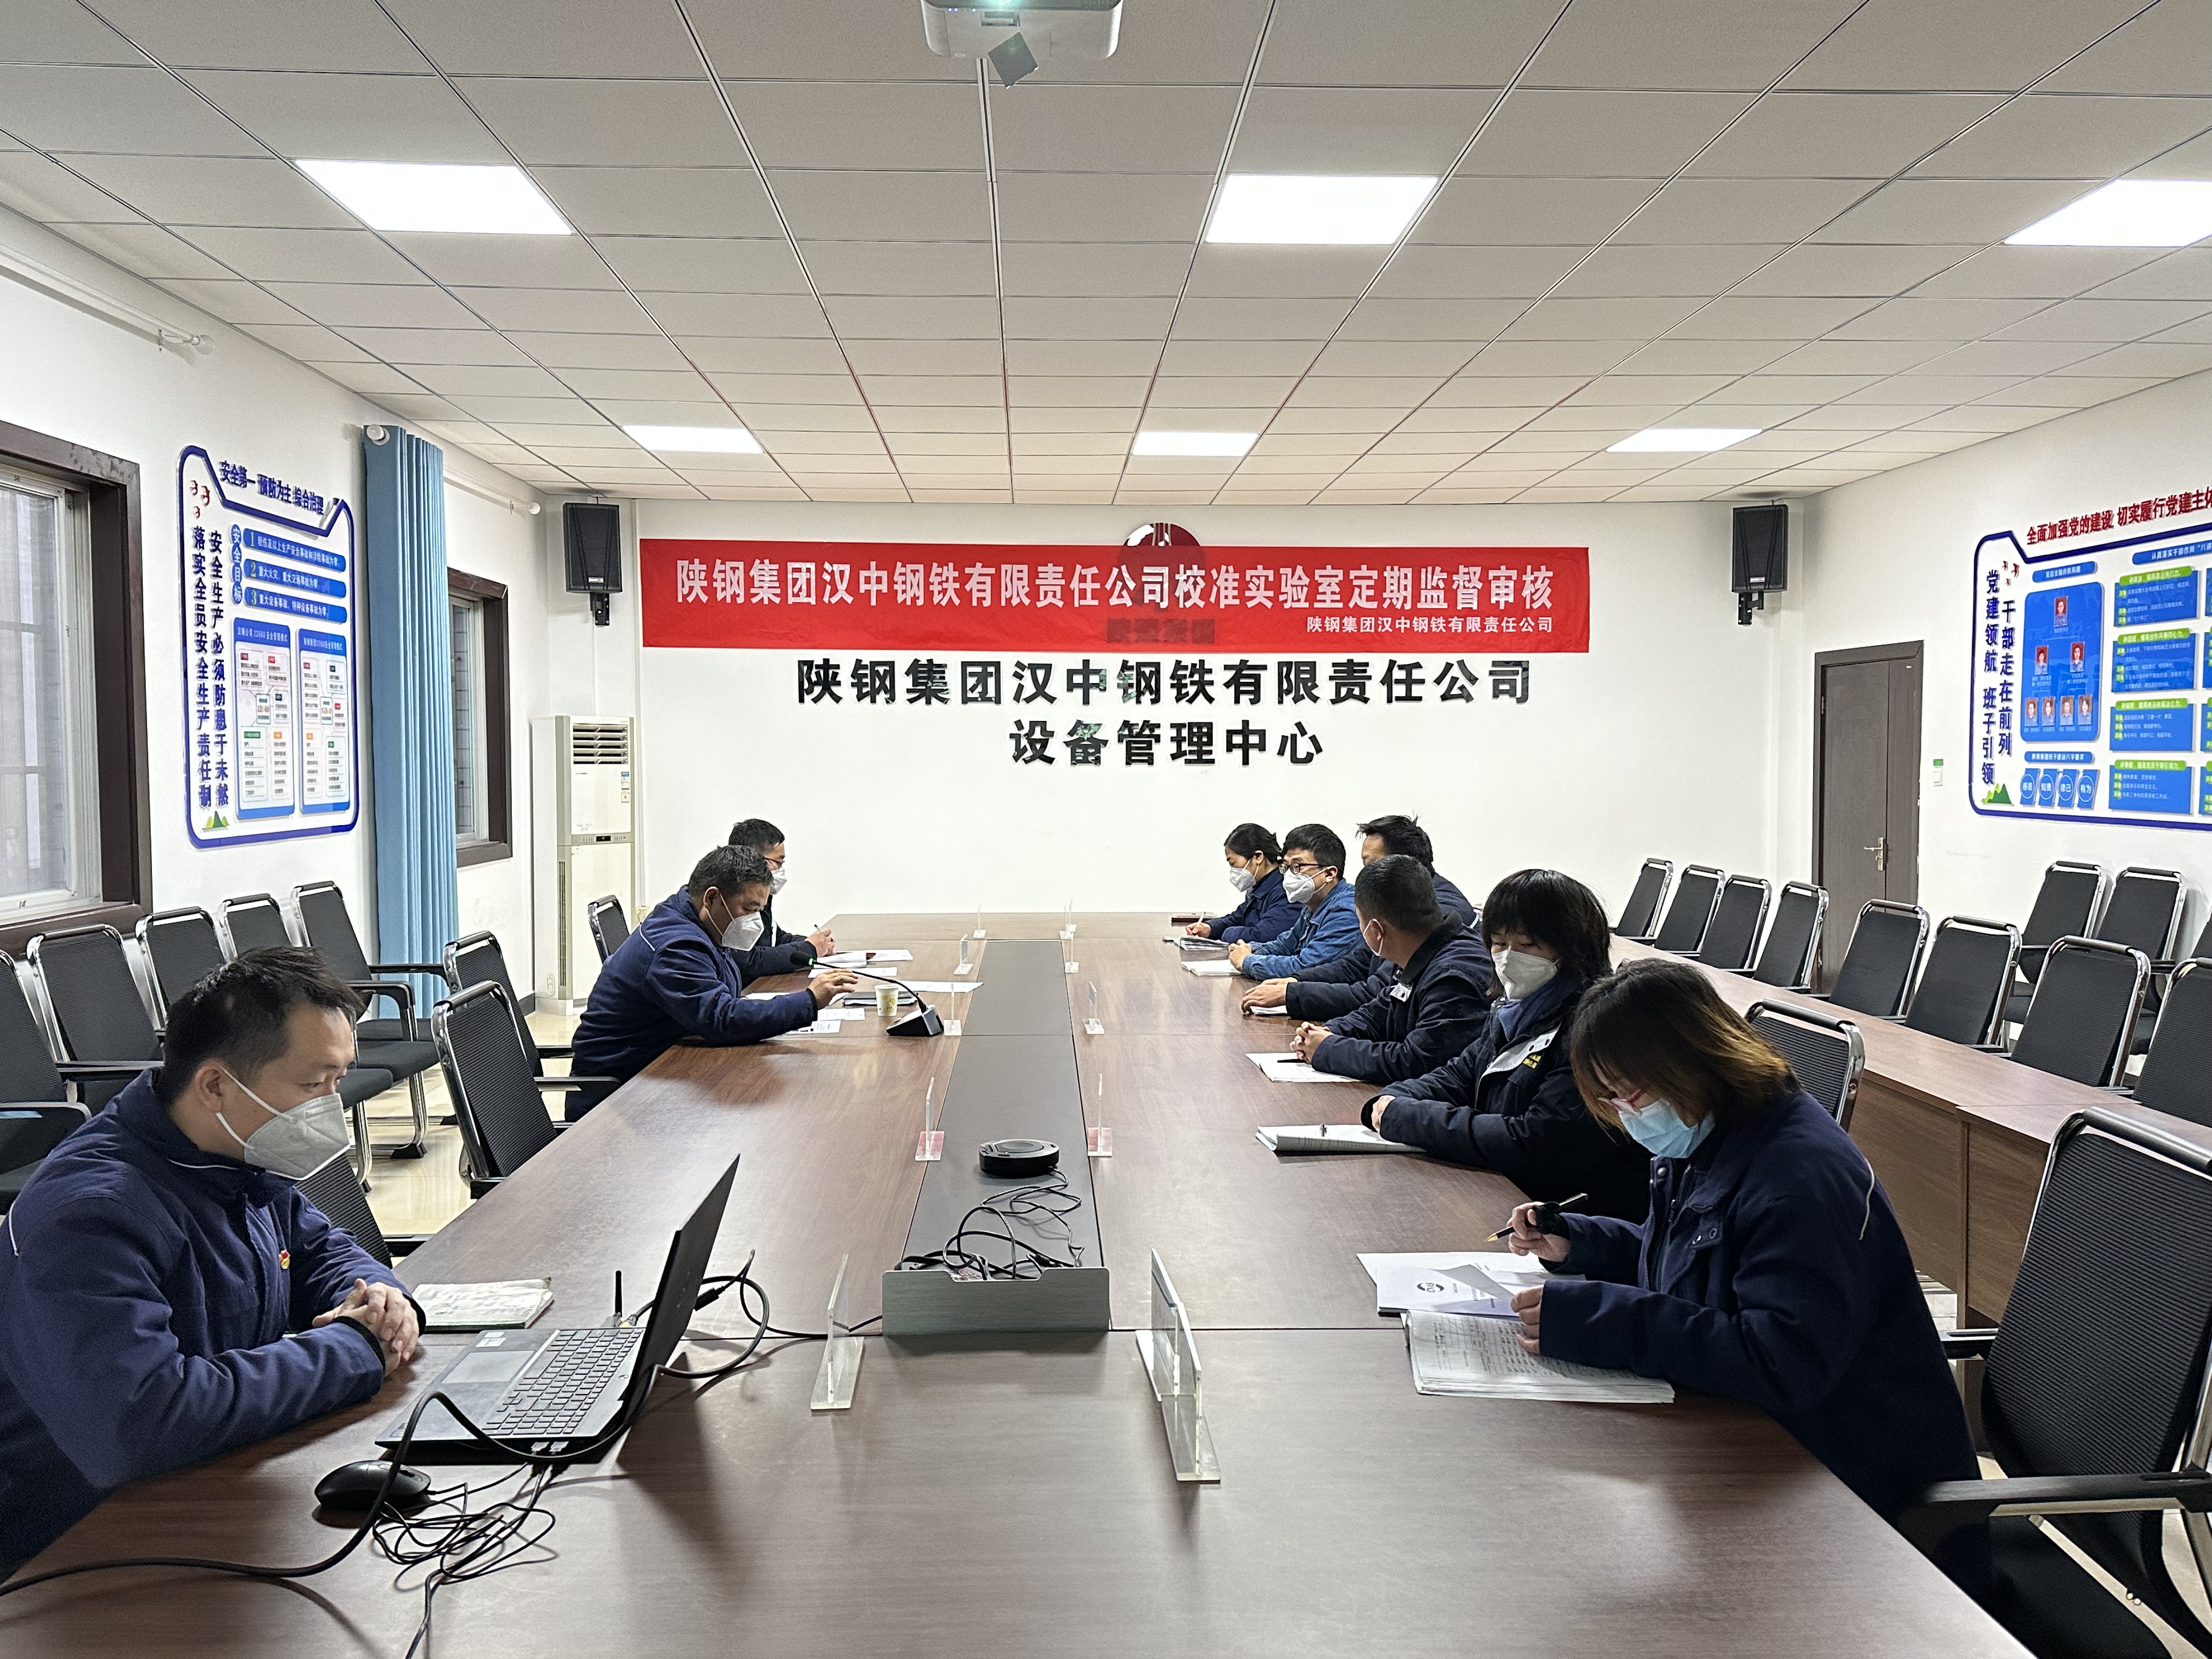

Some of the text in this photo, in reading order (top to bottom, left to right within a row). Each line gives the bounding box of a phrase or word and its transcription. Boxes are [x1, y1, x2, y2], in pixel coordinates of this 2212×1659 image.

[219, 460, 324, 515] 安全第一 预防为主 综合治理
[250, 532, 255, 547] 1
[2027, 510, 2114, 545] 全面加强党的建设
[233, 527, 242, 602] 安全目标
[250, 562, 256, 577] 2
[676, 557, 1553, 612] 陕钢集团汉中钢铁有限责任公司校准实验室定期监督审核
[251, 590, 257, 605] 3
[1307, 616, 1554, 633] 陕钢集团汉中钢铁有限责任公司
[193, 526, 212, 808] 落实全员安全生产责任制
[208, 530, 229, 806] 安全生产必须防患于未然
[797, 658, 1530, 706] 陕钢集团汉中钢铁有限责任公司
[1982, 569, 1999, 786] 党建领航 班子引领
[1999, 600, 2016, 756] 干部走在前列
[1009, 719, 1323, 766] 设备管理中心
[2022, 781, 2092, 794] 感恩 知责 律己 有为
